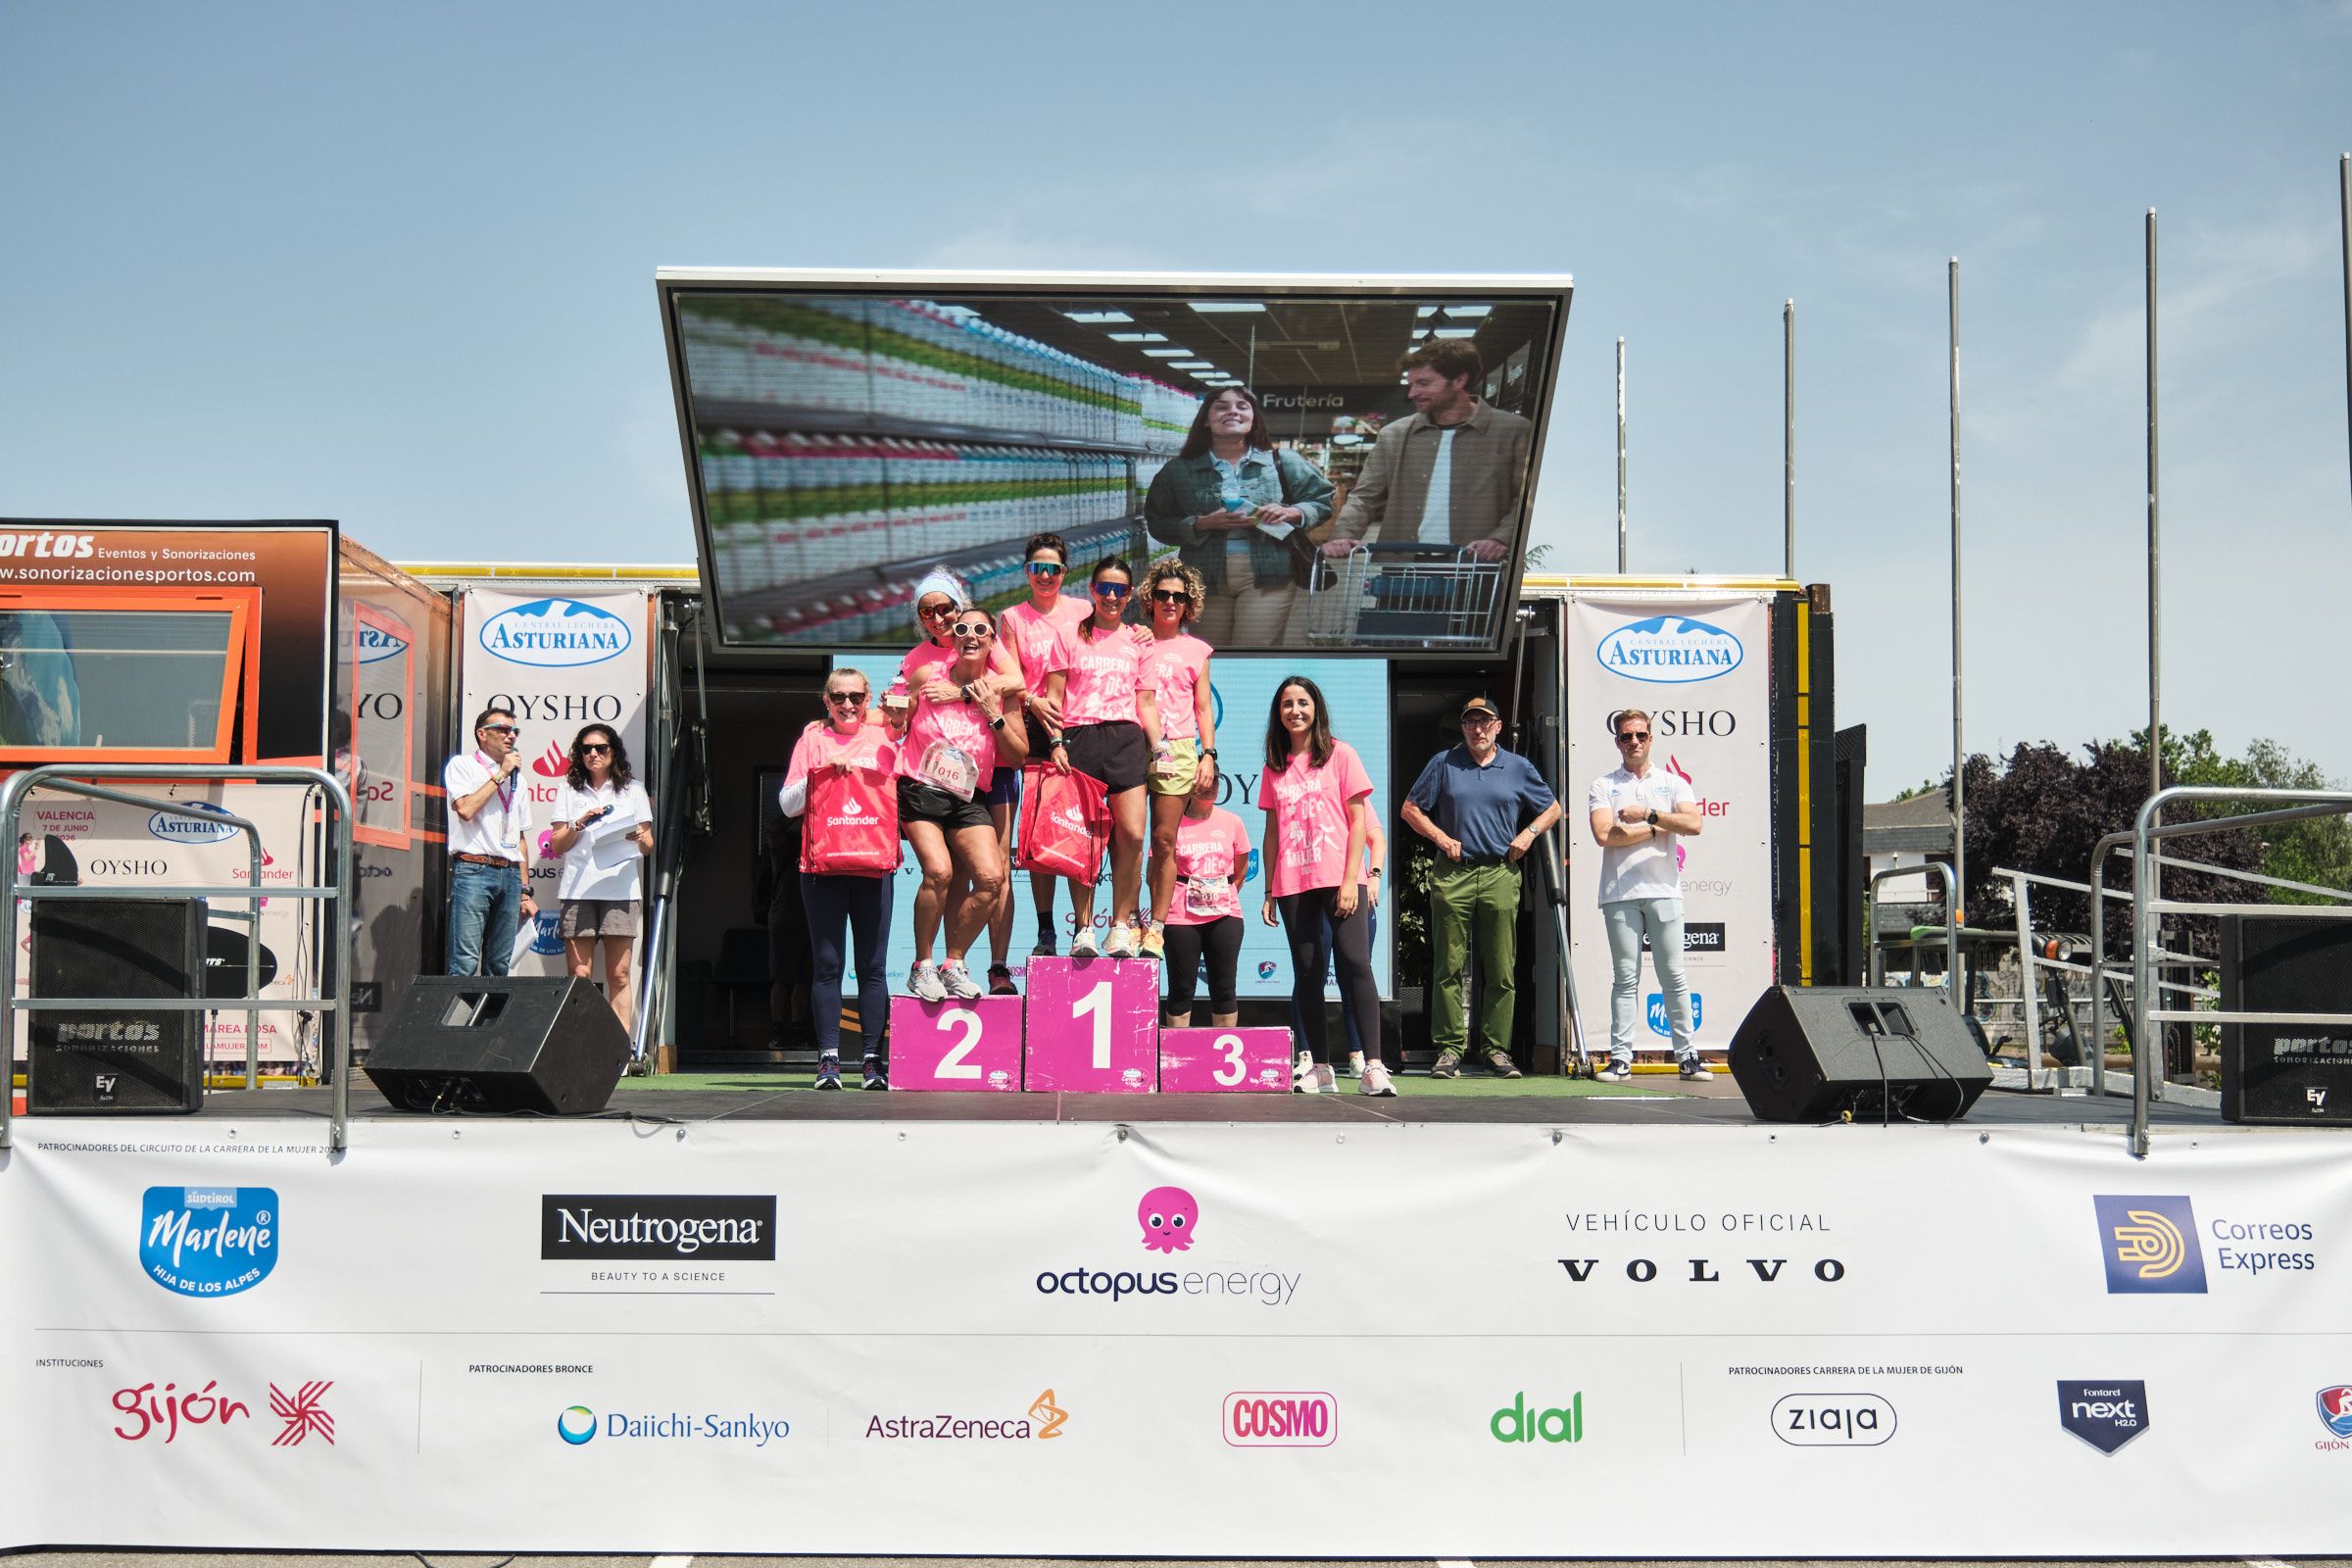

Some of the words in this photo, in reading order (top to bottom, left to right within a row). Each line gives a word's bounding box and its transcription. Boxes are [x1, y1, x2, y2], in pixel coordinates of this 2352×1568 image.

[1263, 393, 1345, 408] Frutería
[0, 531, 94, 558] ortos
[98, 548, 146, 559] Eventos
[151, 551, 157, 561] y
[162, 549, 256, 561] Sonorizaciones
[0, 565, 256, 584] w.sonorizacionesportos.com
[491, 623, 619, 649] ASTURIANA
[1609, 640, 1734, 665] ASTURIANA
[487, 694, 621, 721] OYSHO
[1606, 710, 1736, 736] OSHO
[36, 810, 95, 820] VALENCIA
[156, 816, 233, 833] ASTURIANA
[827, 814, 879, 826] Santander
[1180, 841, 1224, 857] CARRERA
[90, 858, 168, 875] OYSHO
[232, 868, 294, 879] Sanander
[1680, 879, 1733, 896] energy
[58, 1023, 160, 1042] portos
[245, 1024, 277, 1034] OSA
[1072, 982, 1113, 1068] 1
[934, 1008, 983, 1079] 2
[1212, 1035, 1247, 1087] 3
[97, 1076, 116, 1093] EV
[2307, 1089, 2326, 1106] EV
[38, 1143, 118, 1152] PATROCINADORES
[286, 1146, 317, 1154] MUJER
[558, 1208, 760, 1253] Neutrogena
[1566, 1209, 1707, 1232] VEHÍCULO
[1721, 1213, 1831, 1232] OFICIAL
[2211, 1219, 2313, 1241] Correos
[1557, 1258, 1845, 1283] VOLVO
[2218, 1248, 2316, 1275] Express
[153, 1264, 176, 1286] HIJA
[179, 1279, 196, 1292] DE
[198, 1282, 221, 1293] LOS
[224, 1267, 261, 1291] ALPES
[591, 1272, 638, 1281] BEAUTY
[643, 1272, 658, 1281] TO
[662, 1272, 669, 1281] A
[673, 1272, 726, 1282] SCIENCE
[1036, 1267, 1178, 1302] octopus
[1183, 1272, 1301, 1306] energy
[35, 1359, 104, 1368] INSTITUCIONES
[469, 1364, 554, 1373] PATROCINADORES
[1729, 1366, 1811, 1375] PATROCINADORES
[1813, 1366, 1856, 1375] CARRERA
[1935, 1364, 1963, 1374] GIJÓN
[112, 1380, 250, 1444] gijón
[1233, 1398, 1329, 1438] COSMO
[1490, 1391, 1584, 1444] dial
[2072, 1399, 2136, 1418] next
[607, 1412, 790, 1446] Daiichi-Sankyo
[865, 1414, 1031, 1440] AstraZeneca
[2315, 1438, 2350, 1451] GIJÓN
